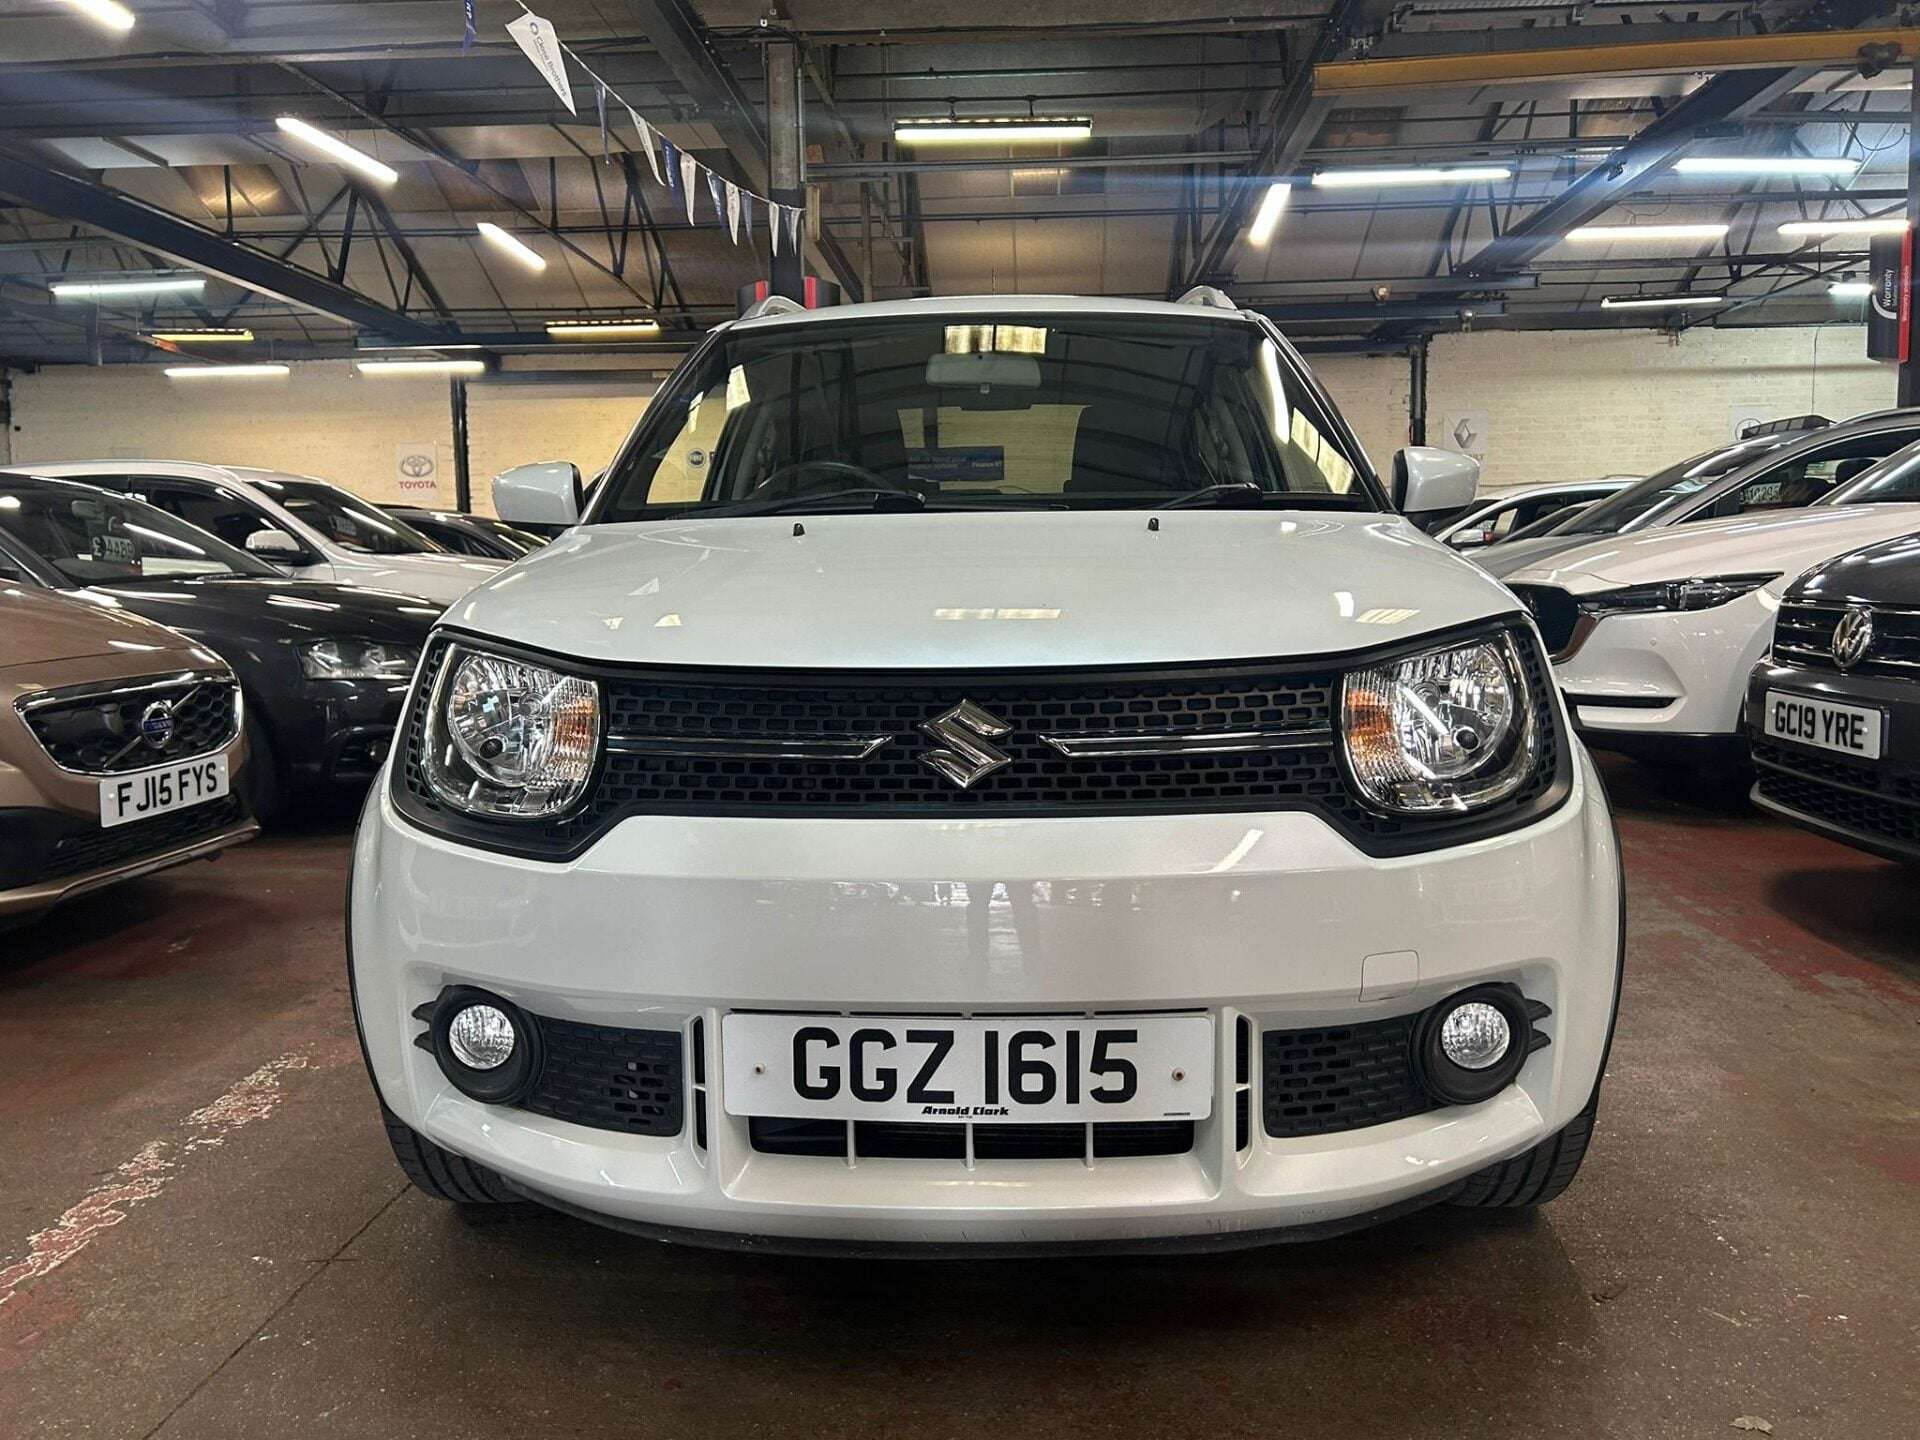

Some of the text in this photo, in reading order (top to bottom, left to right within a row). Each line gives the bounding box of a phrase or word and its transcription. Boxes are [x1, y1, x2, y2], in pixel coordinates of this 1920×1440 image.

[536, 35, 550, 61] Close
[547, 60, 567, 97] Brothers
[1882, 269, 1894, 307] Warranty
[398, 481, 437, 490] TOYOTA
[1774, 701, 1865, 750] GC19 YRE
[117, 760, 218, 818] FJ15 FYS
[792, 1026, 1138, 1106] GGZ 1615
[921, 1105, 1009, 1116] Arnold Clark
